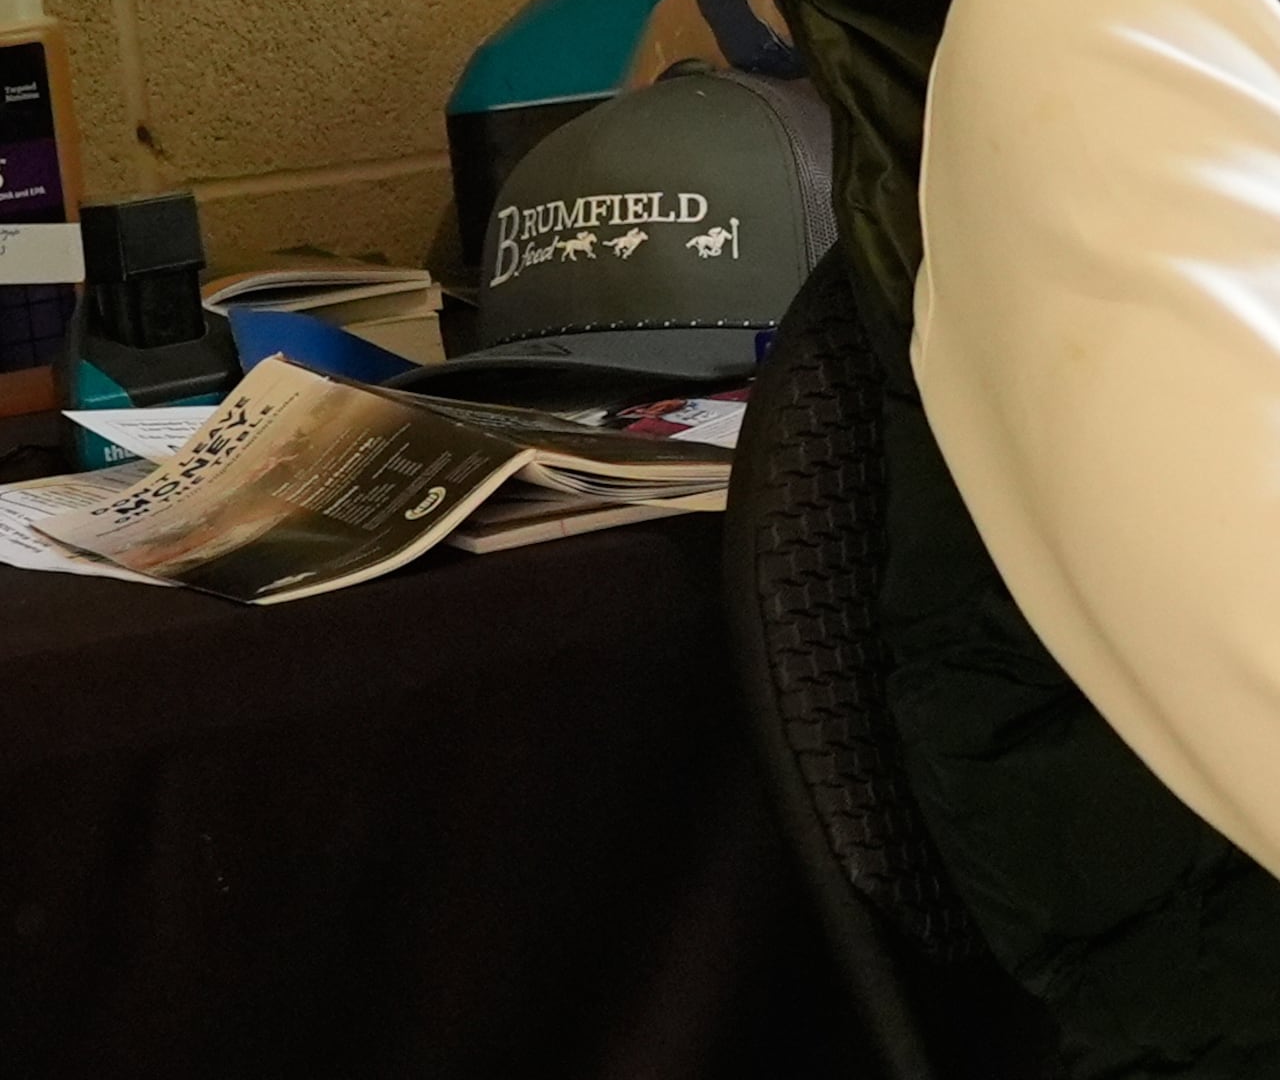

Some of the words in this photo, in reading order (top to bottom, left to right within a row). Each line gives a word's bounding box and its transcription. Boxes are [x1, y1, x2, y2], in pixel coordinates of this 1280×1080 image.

[490, 192, 708, 287] BRUMFIELD
[115, 409, 248, 515] MONEY
[162, 476, 205, 503] THE
[209, 405, 274, 468] TABLE
[178, 396, 251, 467] LEAVE
